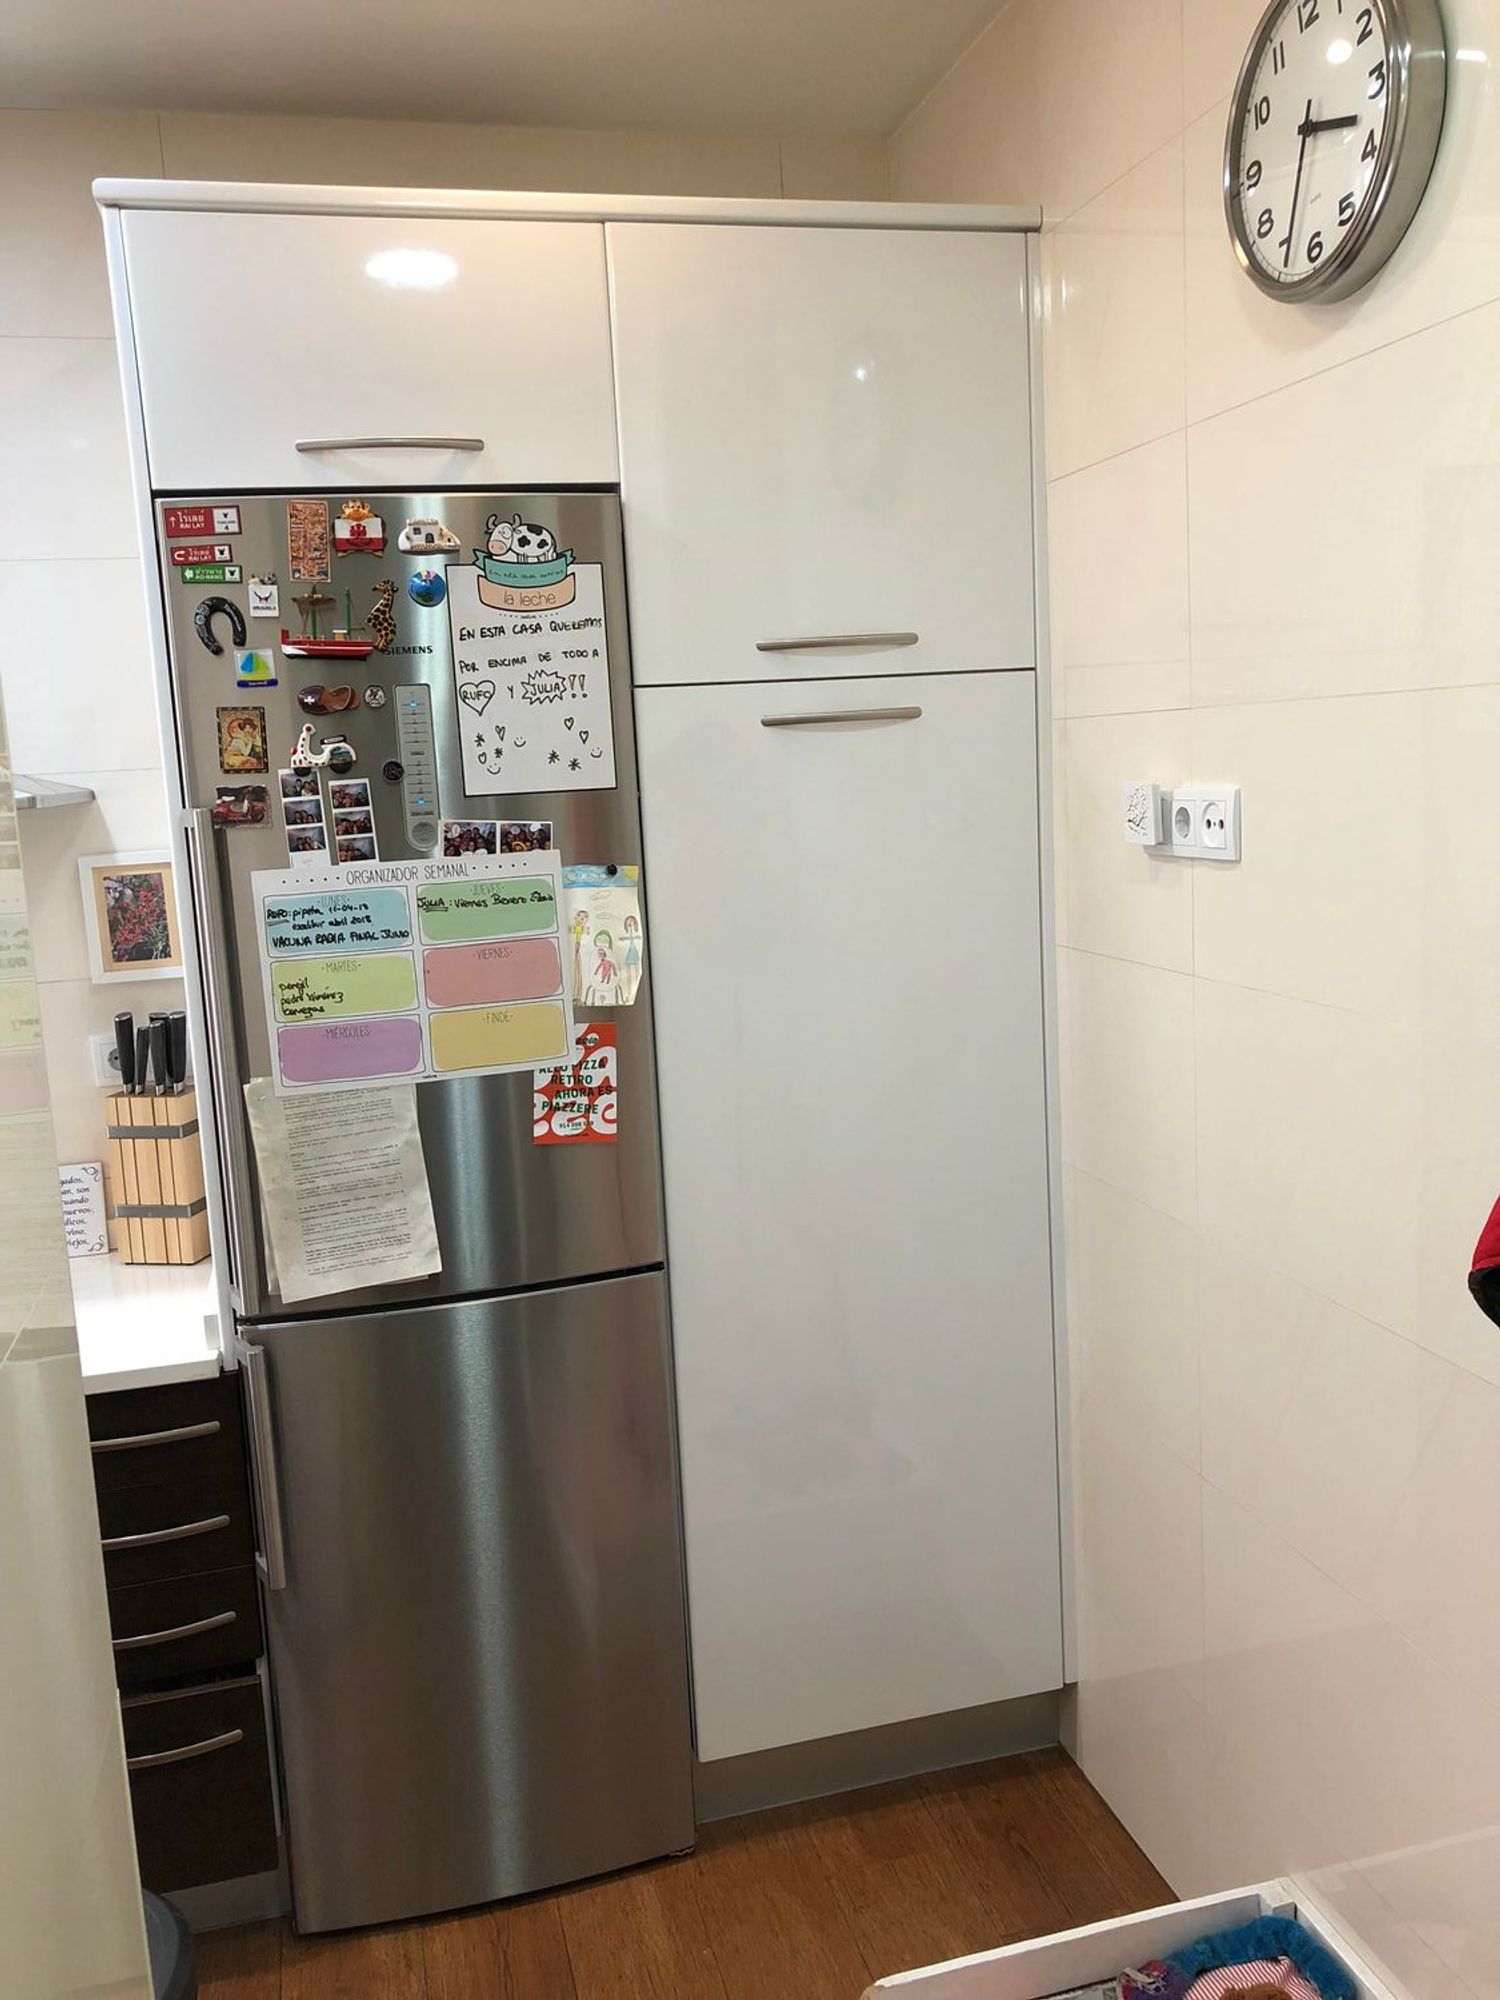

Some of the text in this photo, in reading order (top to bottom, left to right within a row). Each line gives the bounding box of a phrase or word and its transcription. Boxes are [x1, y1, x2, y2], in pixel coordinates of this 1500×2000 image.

[1297, 0, 1320, 34] 12
[1355, 8, 1373, 46] 2
[1272, 41, 1285, 75] 11
[1368, 60, 1385, 99] 3
[1254, 96, 1270, 131] 10
[1361, 129, 1377, 162] 4
[1246, 160, 1262, 190] 9
[1338, 192, 1355, 227] 5
[1257, 208, 1274, 239] 8
[1306, 231, 1323, 263] 6
[503, 591, 557, 607] la leche
[459, 627, 475, 641] EN
[480, 626, 506, 638] ESTA
[512, 622, 543, 635] CASA
[385, 645, 433, 656] SIEMENS
[459, 649, 600, 674] POR ENCIMA DE TODO A
[507, 685, 515, 700] Y
[530, 682, 561, 696] JULIA
[345, 863, 470, 885] ORGANIZADOR SEMANAL
[476, 946, 510, 960] VIERNES
[325, 960, 359, 974] MARTES
[486, 1010, 511, 1024] FINDE
[550, 1074, 593, 1086] RETIRO
[554, 1085, 613, 1100] AHORA ES
[541, 1100, 599, 1115] PIAZZERE
